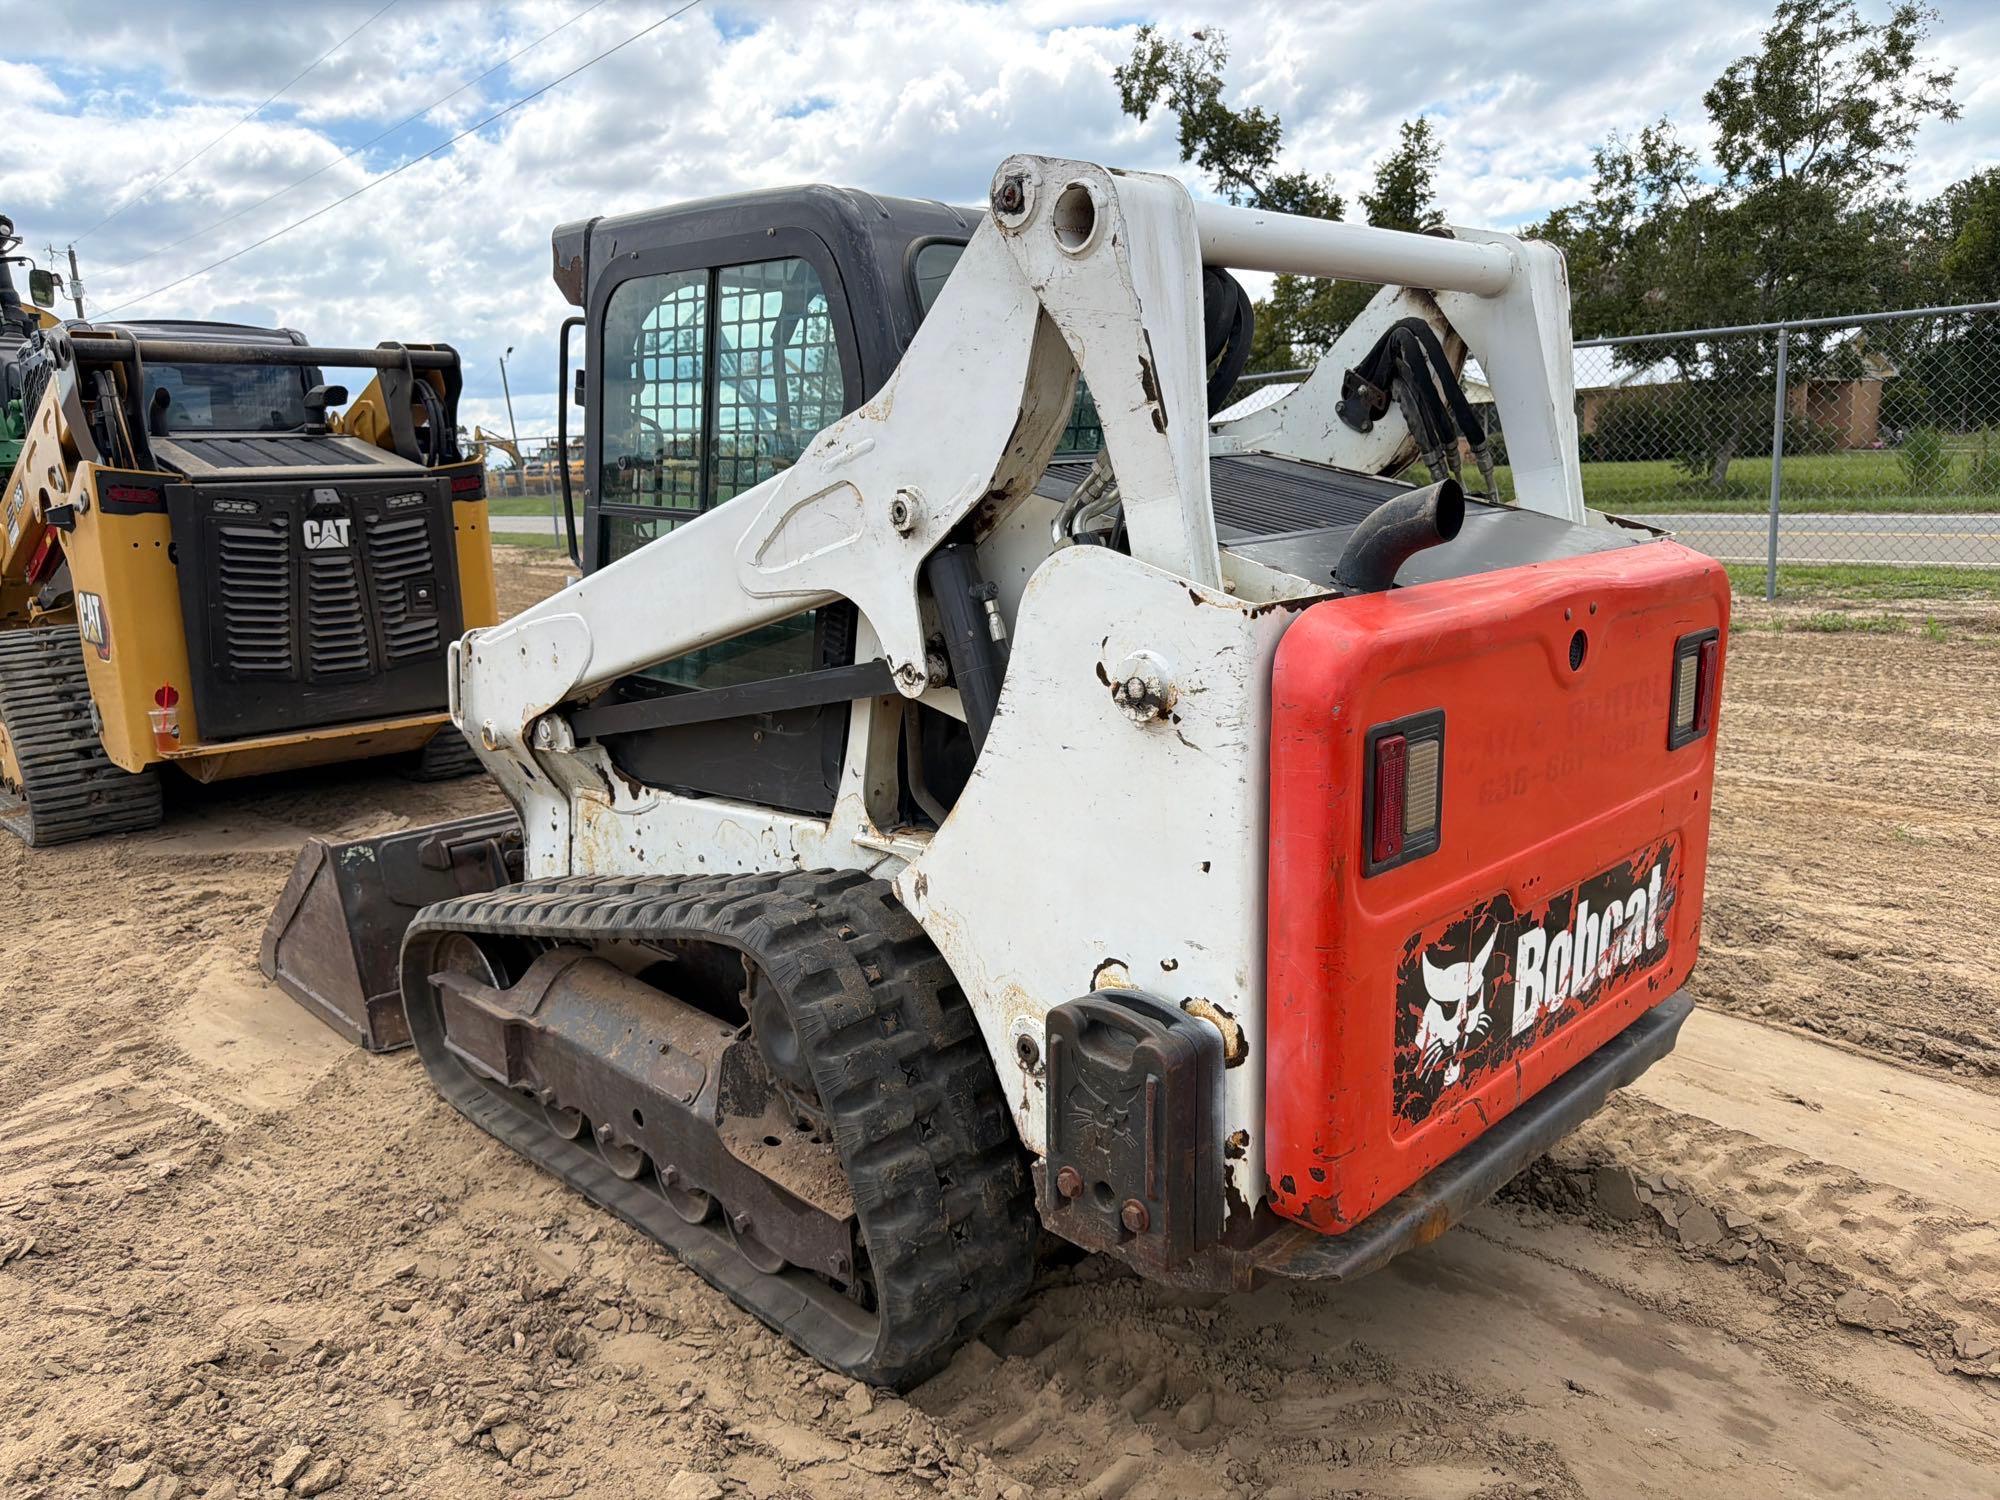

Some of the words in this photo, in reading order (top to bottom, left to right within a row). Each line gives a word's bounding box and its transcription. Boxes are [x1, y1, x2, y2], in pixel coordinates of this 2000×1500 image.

[303, 518, 351, 550] CAT
[78, 592, 104, 645] CAT
[1512, 864, 1662, 1038] Bobcat
